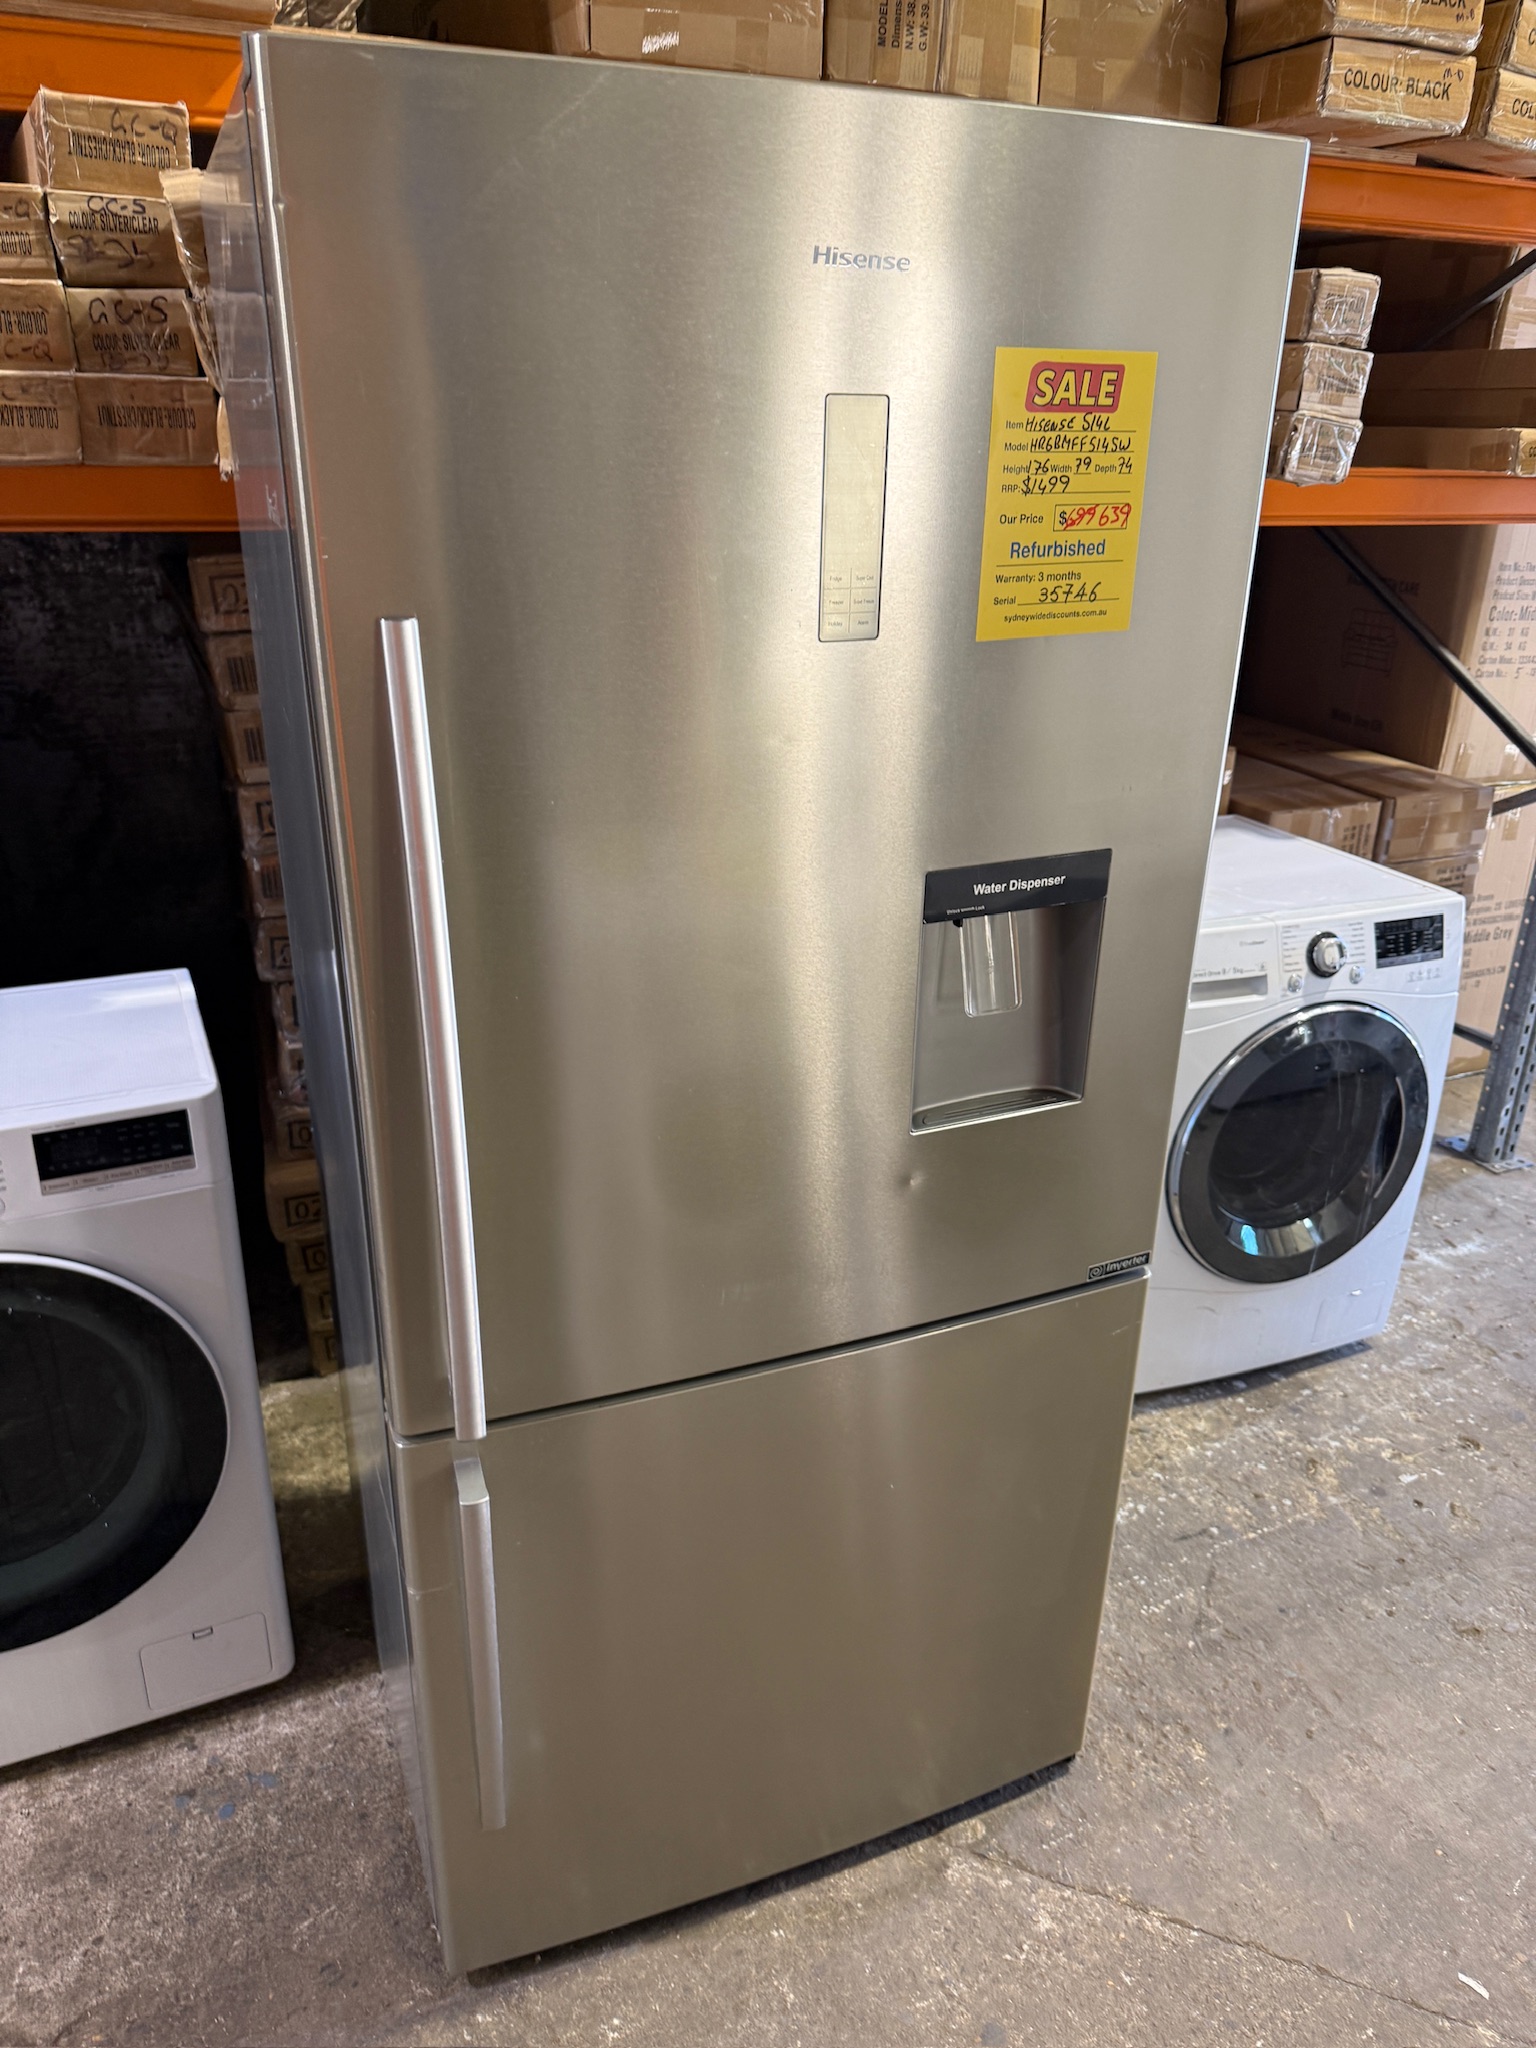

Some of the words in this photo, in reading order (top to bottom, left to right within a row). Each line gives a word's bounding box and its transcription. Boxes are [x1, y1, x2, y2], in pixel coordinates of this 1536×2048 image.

[877, 0, 888, 47] MODEL
[1344, 67, 1403, 94] COLOUR:
[1405, 72, 1451, 101] BLACK
[67, 132, 136, 164] BLACK/CHESTNUT
[137, 143, 171, 169] COLOUR:
[100, 213, 160, 236] SILVER/CLEAR
[812, 244, 911, 272] Hisense
[12, 311, 48, 335] COLOUR:
[1032, 369, 1119, 407] SALE
[25, 406, 59, 430] COLOUR:
[97, 404, 164, 429] BLACK/CHESTNUT
[164, 407, 196, 431] COLOUR:
[1005, 420, 1024, 429] Item
[1004, 442, 1029, 451] Model
[1002, 464, 1029, 475] Height
[1050, 464, 1072, 473] Width
[1094, 464, 1117, 475] Depth
[1001, 484, 1021, 493] RRP:
[1021, 475, 1070, 496] $1499
[999, 514, 1017, 524] Our
[1020, 513, 1044, 524] Price
[1010, 538, 1106, 559] Refurbished
[995, 573, 1036, 584] Warranty:
[1038, 571, 1044, 582] 3
[1046, 570, 1081, 582] months
[993, 596, 1016, 606] Serial
[1038, 581, 1102, 604] 35746
[1004, 609, 1108, 623] sydneywidediscounts.com.au
[1489, 605, 1518, 622] Color:
[973, 882, 1007, 896] Water
[1009, 875, 1066, 891] Dispenser
